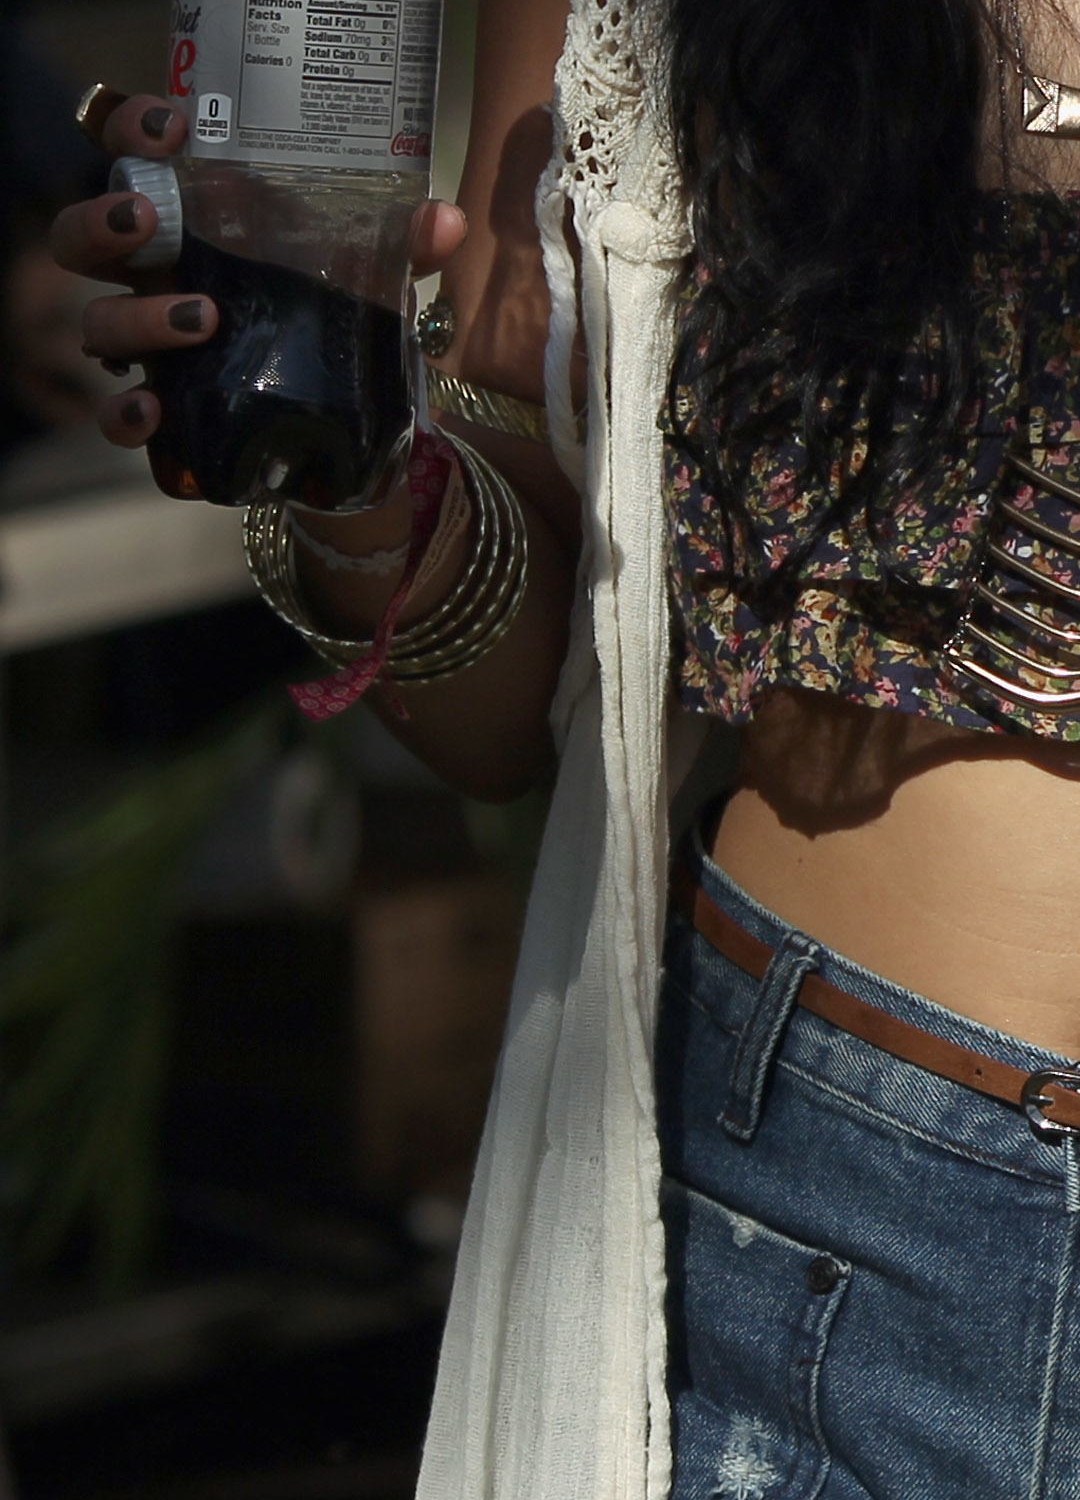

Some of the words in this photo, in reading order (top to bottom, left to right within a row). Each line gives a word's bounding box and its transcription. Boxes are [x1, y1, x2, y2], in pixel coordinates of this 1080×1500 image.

[248, 8, 281, 21] Facts
[271, 22, 290, 34] Size
[306, 15, 332, 27] Total
[335, 17, 352, 28] Fat
[354, 18, 366, 30] 0g
[383, 20, 396, 31] 0%
[254, 34, 281, 46] Bottle
[304, 31, 342, 43] Sodium
[343, 33, 371, 46] 70mg
[381, 35, 395, 46] 3%
[245, 53, 284, 67] Calories
[285, 55, 293, 67] 0
[304, 47, 330, 58] Total
[333, 48, 356, 60] Carb
[358, 51, 370, 62] 0g
[380, 51, 394, 62] 0%
[303, 63, 340, 76] Protein
[342, 65, 355, 77] 0g
[208, 98, 219, 118] 0
[198, 117, 228, 129] CALORIES
[208, 128, 228, 138] BOTTLE
[262, 132, 273, 140] THE
[274, 133, 309, 143] COCA-COLA
[238, 140, 275, 150] CONSUMER
[277, 143, 323, 153] INFORMATION
[324, 145, 341, 154] CALL
